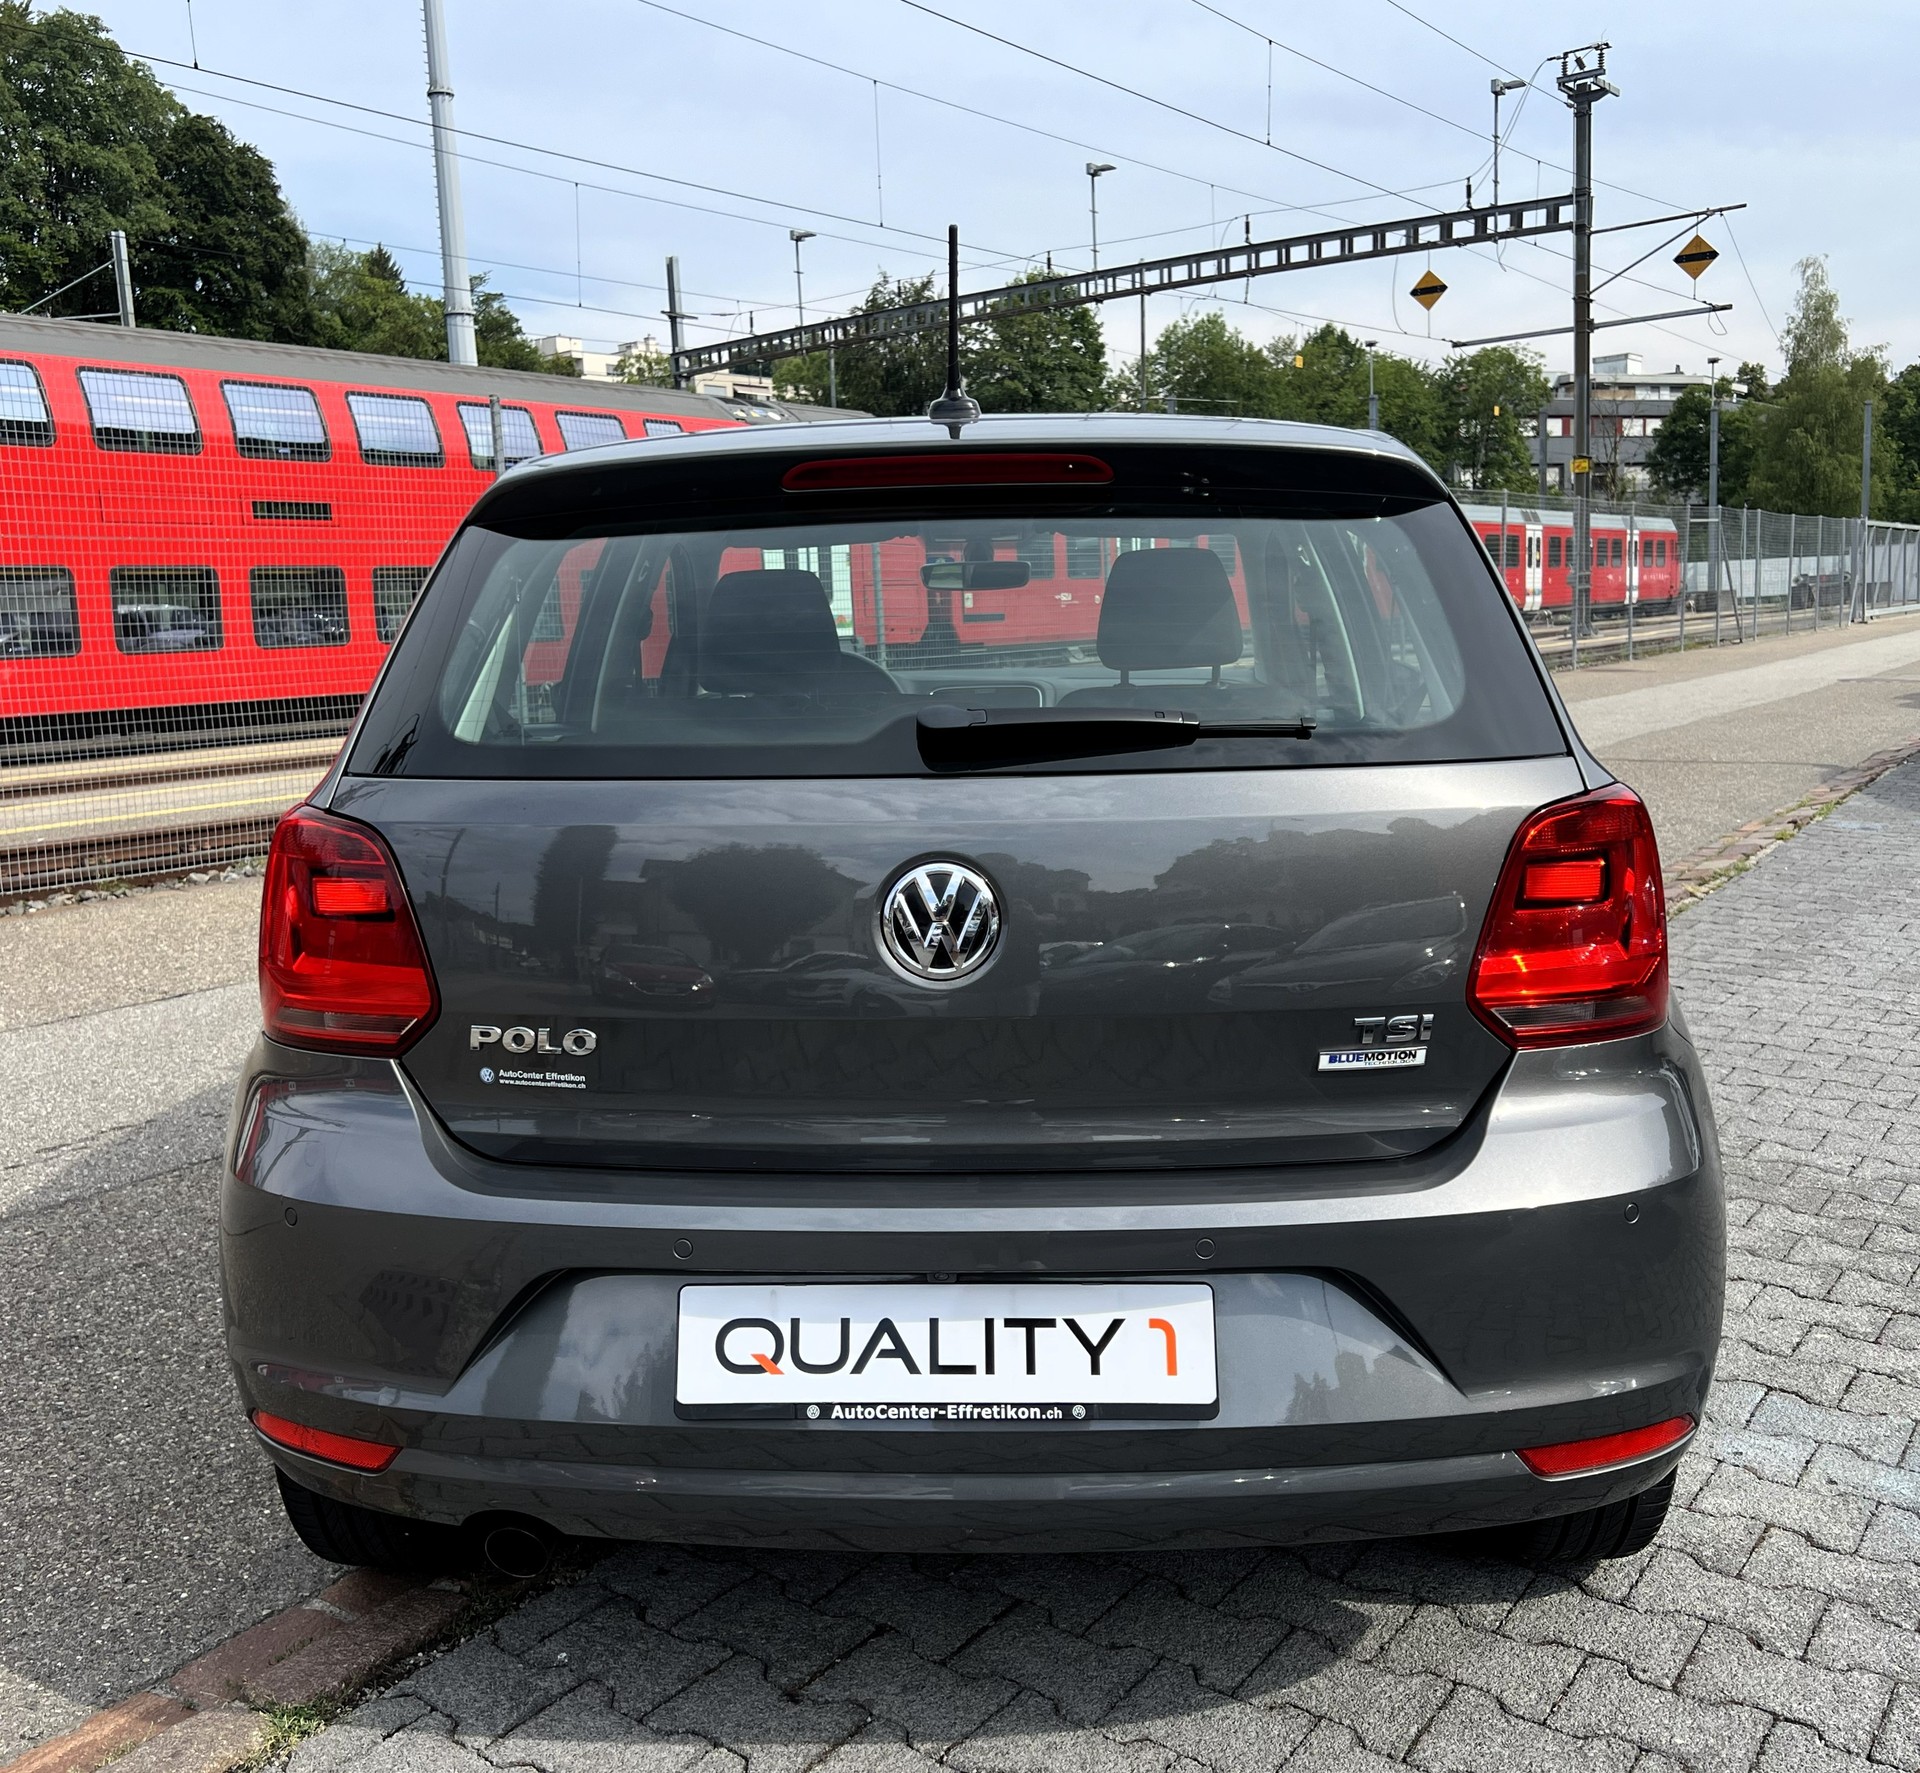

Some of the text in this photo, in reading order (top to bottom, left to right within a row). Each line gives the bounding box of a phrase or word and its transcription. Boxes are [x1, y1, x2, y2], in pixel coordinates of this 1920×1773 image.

[1354, 1013, 1434, 1044] TSI
[470, 1025, 598, 1056] POLO
[1328, 1050, 1418, 1064] BLUEMOTION
[499, 1069, 586, 1082] AutoCenter Effretikon
[499, 1079, 587, 1089] www.autocentereffretikon.ch
[714, 1317, 1178, 1377] QUALITY 1
[830, 1404, 1063, 1420] AutoCenter-Effretikon.ch
